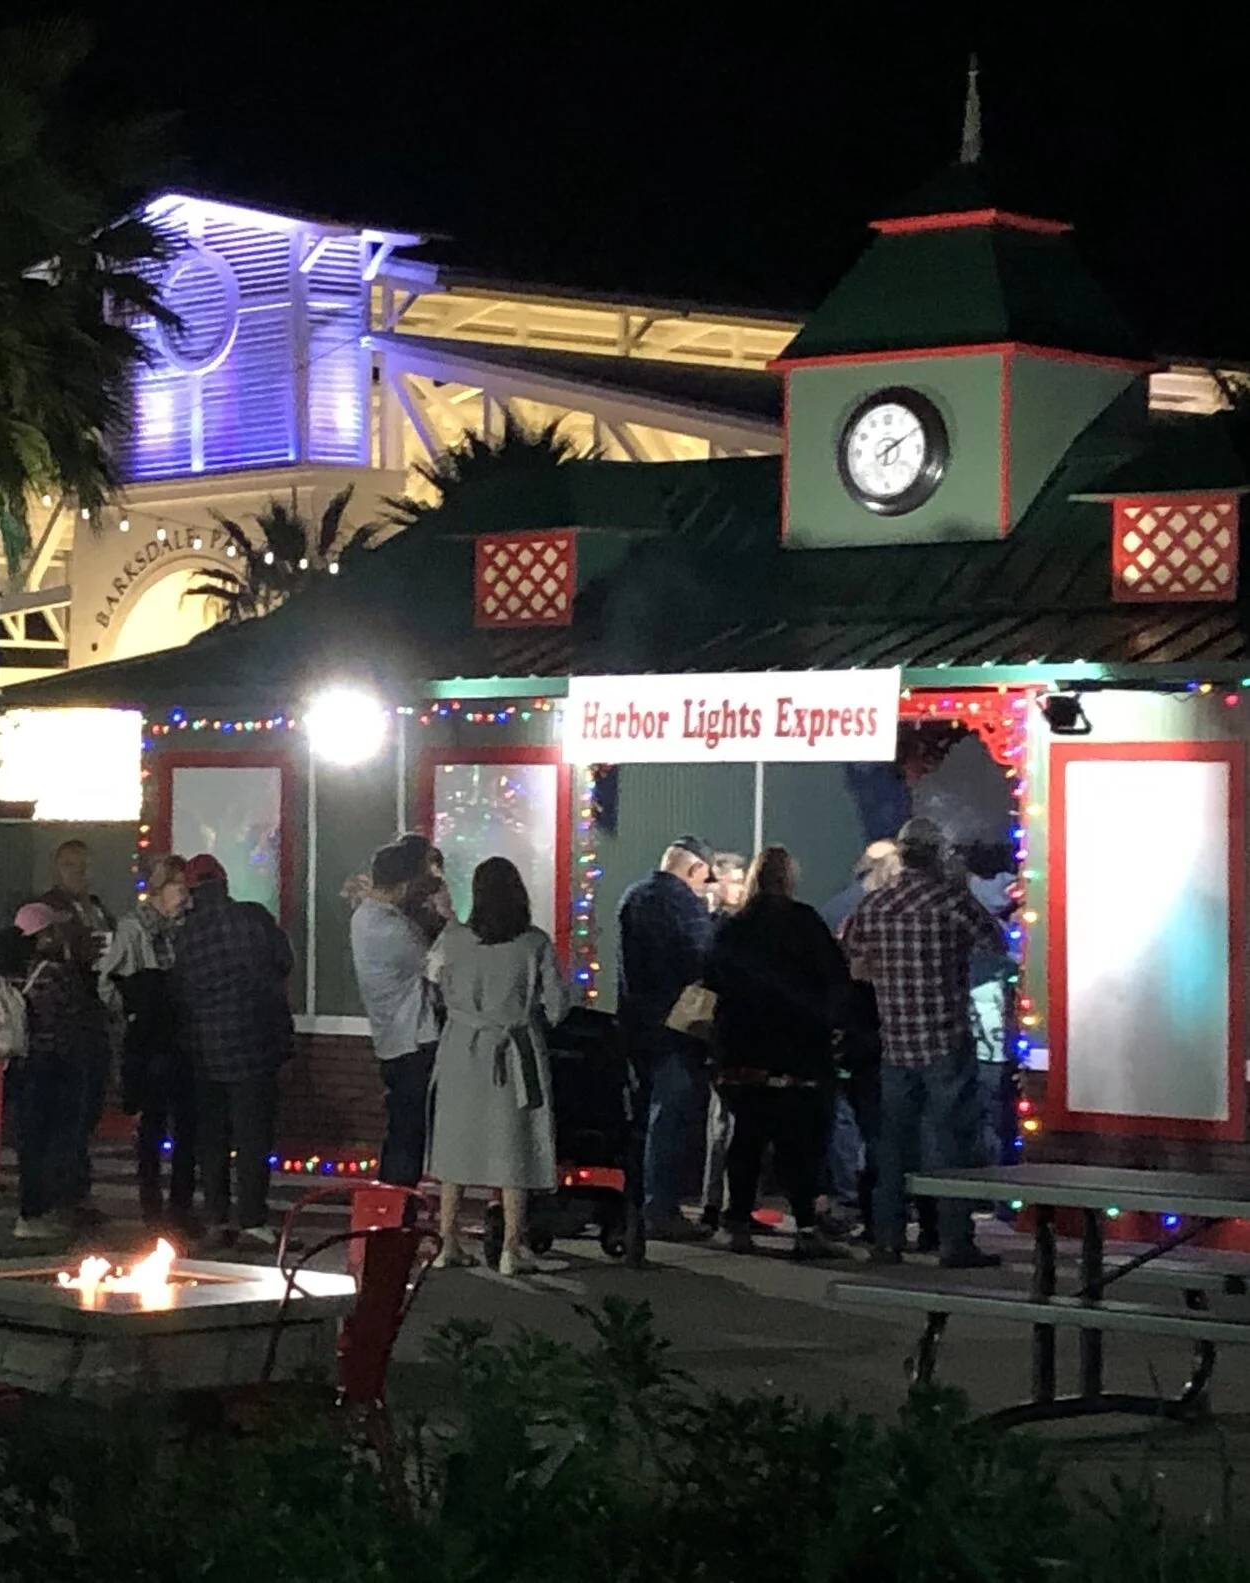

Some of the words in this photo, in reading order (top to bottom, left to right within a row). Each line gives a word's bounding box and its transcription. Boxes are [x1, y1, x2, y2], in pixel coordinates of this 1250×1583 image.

[96, 528, 201, 628] BARKSDALE
[582, 701, 669, 739] Harbor
[682, 698, 762, 749] Lights
[775, 697, 877, 746] Express
